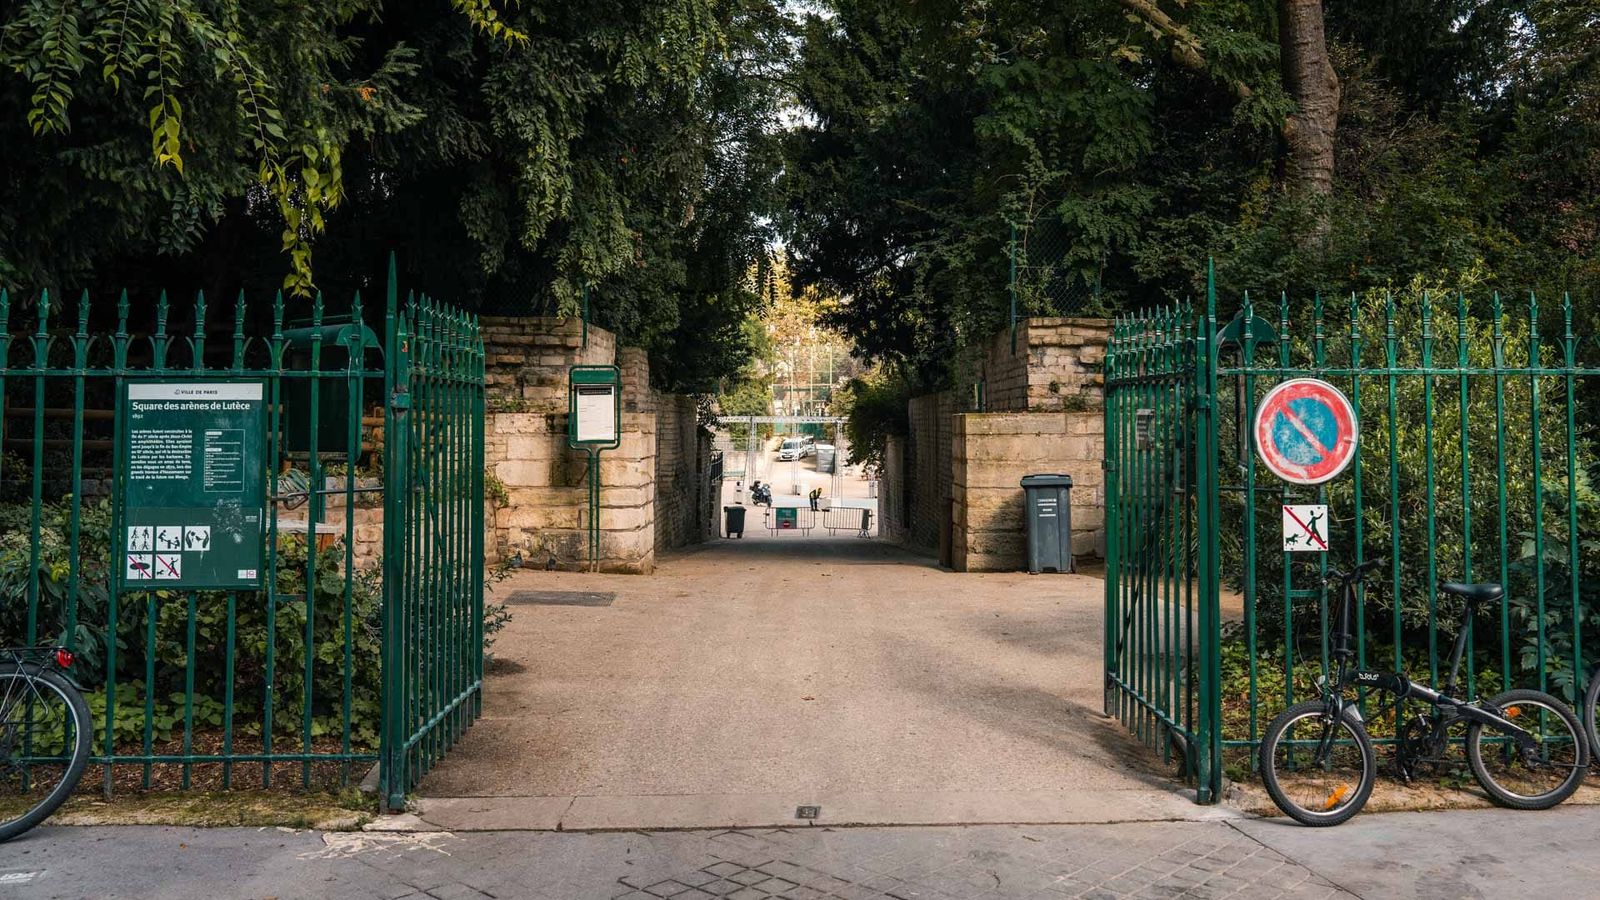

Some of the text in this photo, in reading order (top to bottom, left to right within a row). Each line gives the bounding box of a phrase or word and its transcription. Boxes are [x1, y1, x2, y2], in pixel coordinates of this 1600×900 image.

[132, 401, 250, 412] Square des arènes de Lutèce
